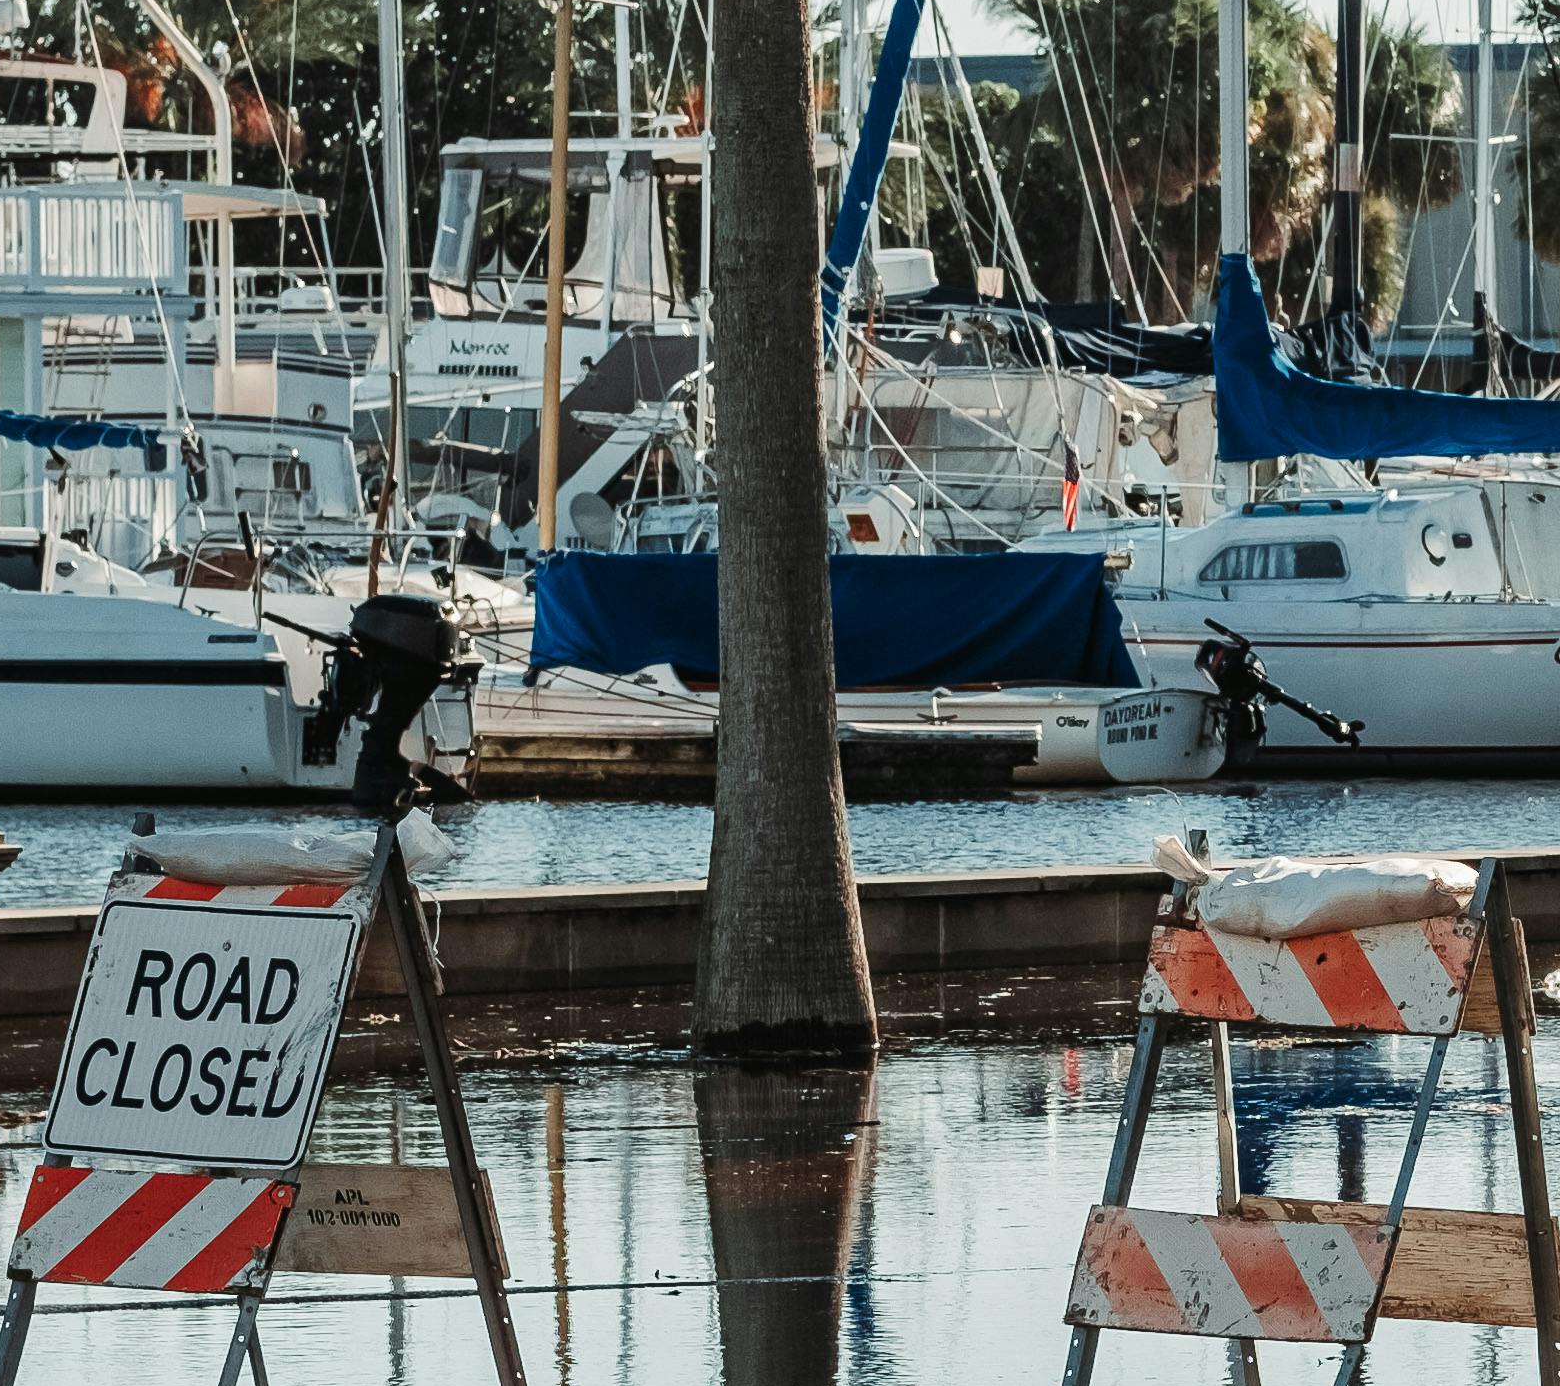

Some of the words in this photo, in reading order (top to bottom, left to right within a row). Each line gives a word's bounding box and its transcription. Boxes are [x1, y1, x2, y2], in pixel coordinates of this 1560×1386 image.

[1104, 697, 1161, 727] DAYDREAM
[125, 948, 300, 1025] ROAD
[75, 1037, 305, 1119] CLOSED
[335, 1189, 370, 1206] APL
